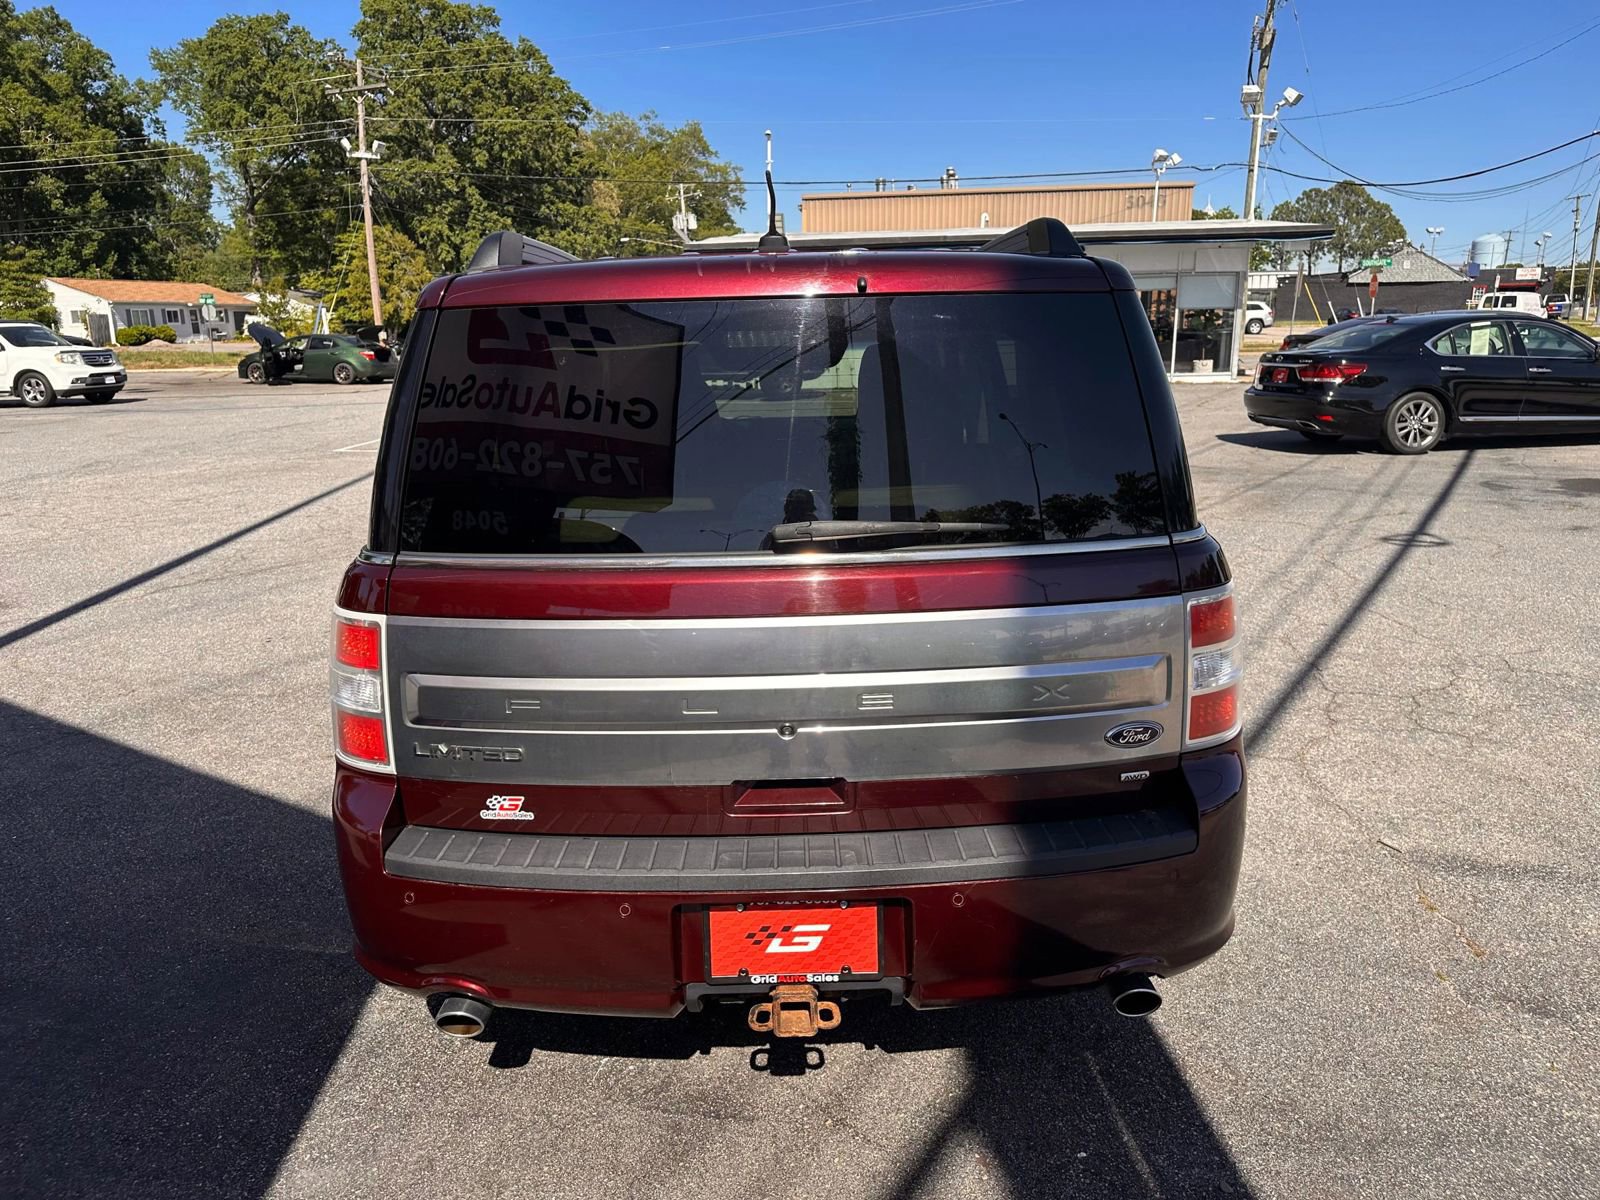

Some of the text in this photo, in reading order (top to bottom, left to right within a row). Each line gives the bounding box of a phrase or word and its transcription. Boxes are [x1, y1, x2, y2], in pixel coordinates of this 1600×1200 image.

[1119, 727, 1152, 744] Ford
[413, 741, 523, 762] LIMITED
[1122, 772, 1149, 782] AWD
[481, 811, 533, 819] GridAutoSales
[750, 974, 840, 984] GridAutoSales
